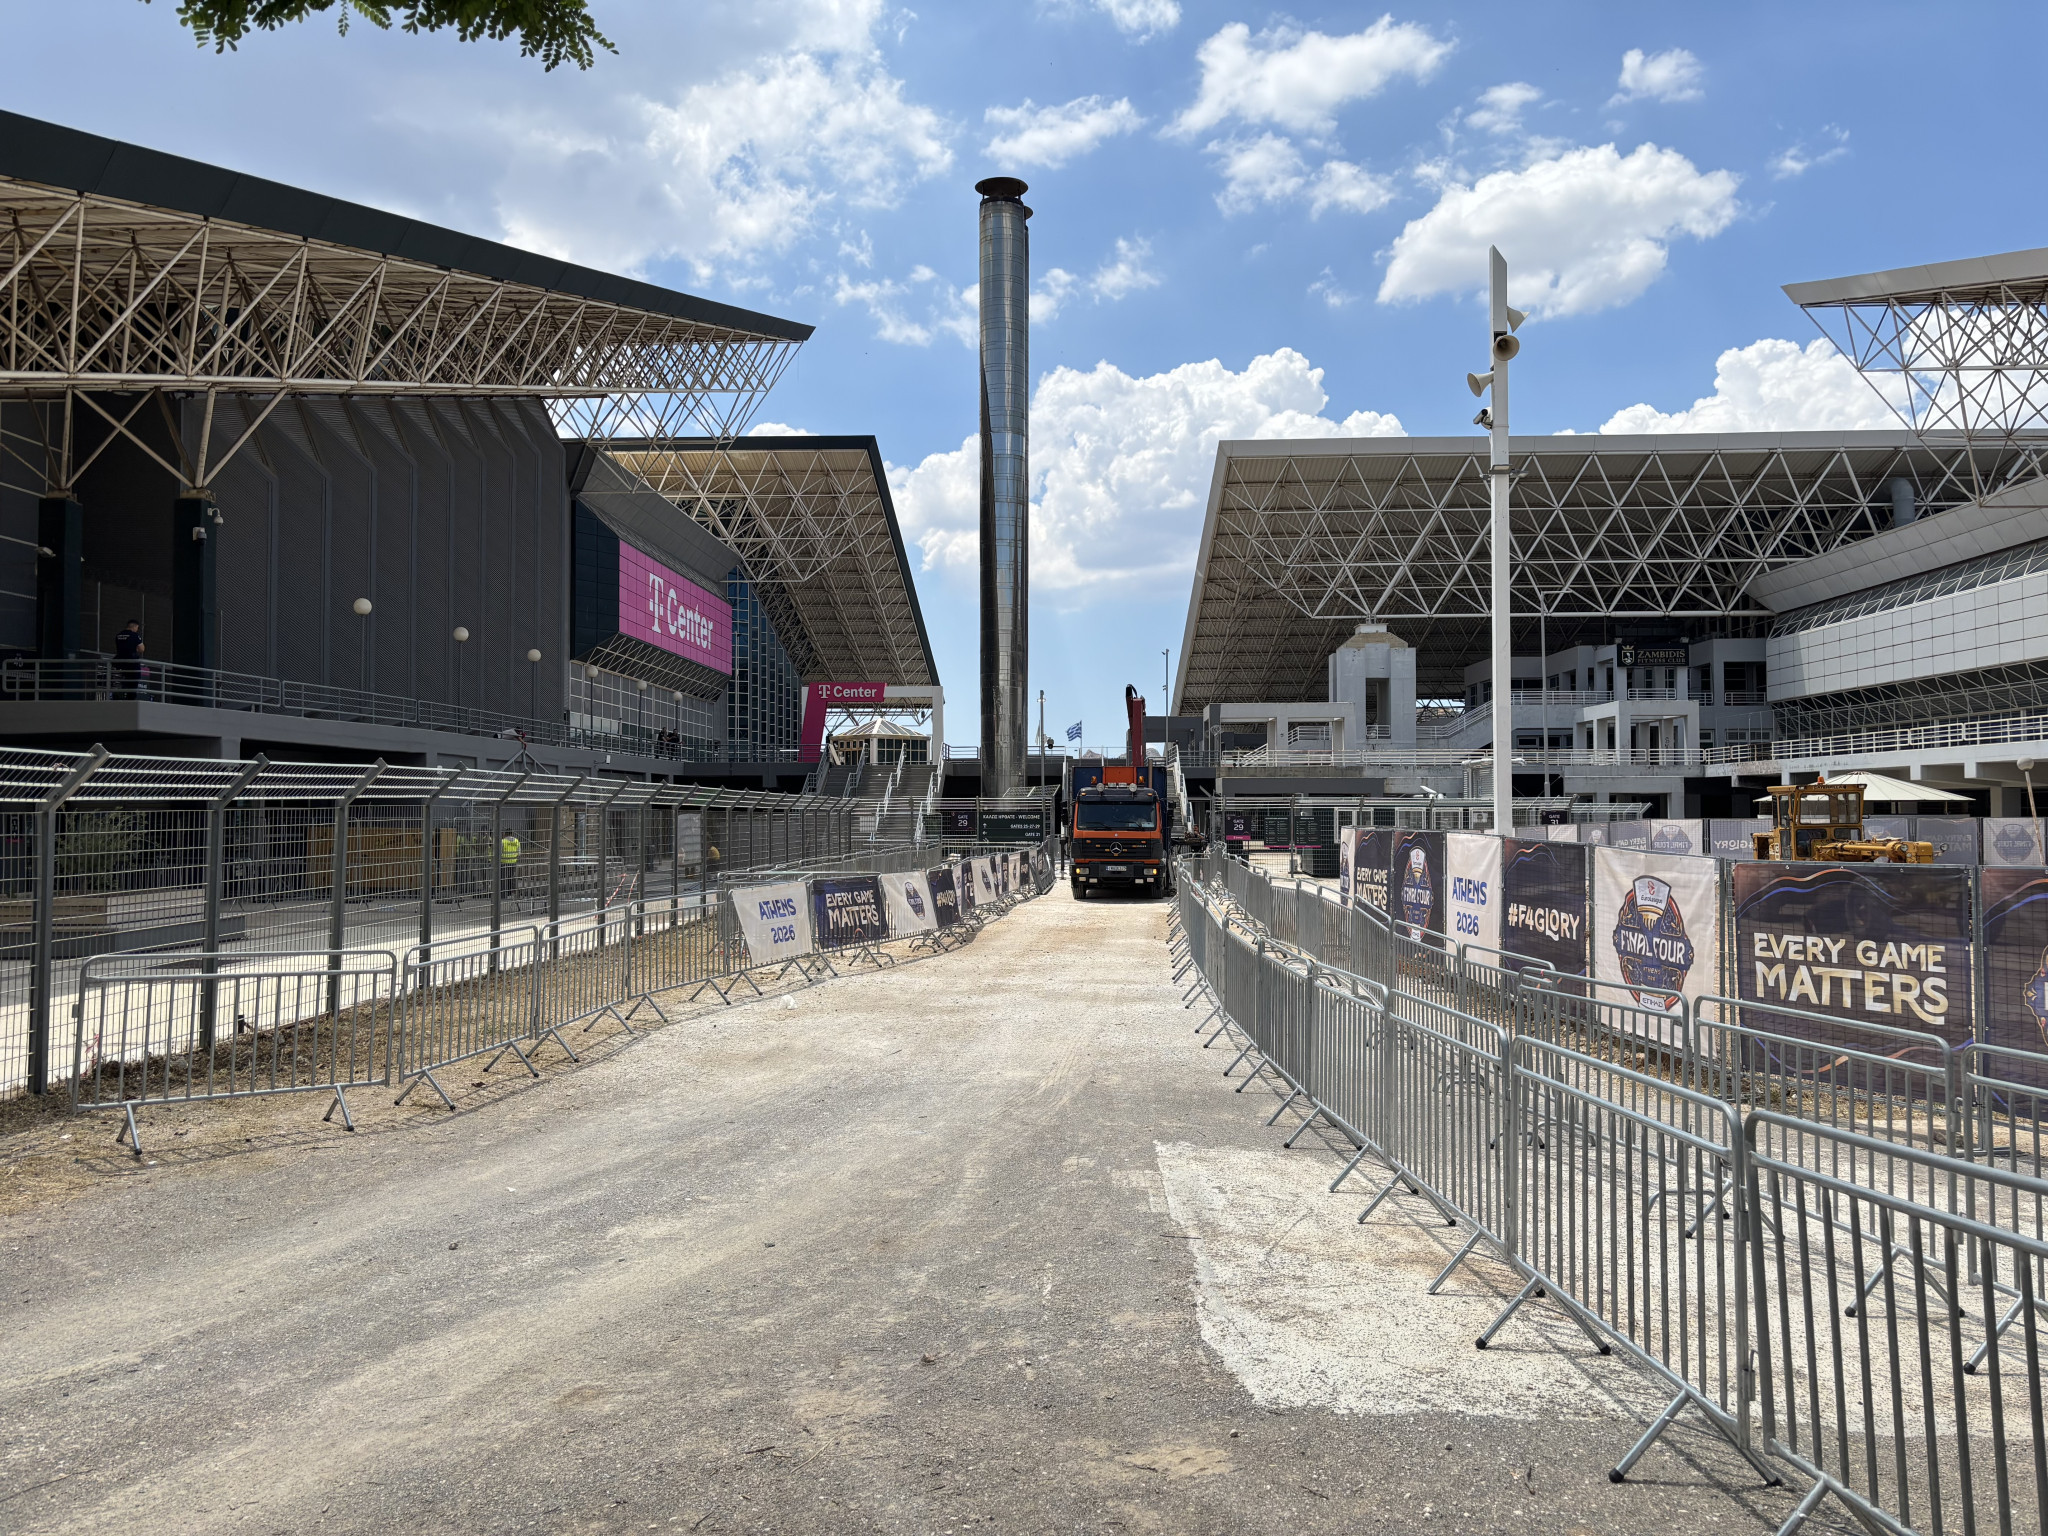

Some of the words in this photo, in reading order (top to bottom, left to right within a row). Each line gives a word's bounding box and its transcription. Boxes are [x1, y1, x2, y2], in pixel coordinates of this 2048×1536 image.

[650, 572, 664, 634] T
[668, 588, 714, 650] Center
[818, 684, 831, 699] T
[834, 686, 877, 698] Center
[1357, 867, 1372, 883] EVERY
[1372, 868, 1388, 883] GAME
[826, 892, 852, 907] EVERY
[853, 889, 875, 904] GAME
[1356, 883, 1387, 910] MATTERS
[1417, 888, 1430, 905] FOUR
[1452, 876, 1488, 906] ATHENS
[758, 898, 797, 921] ATHENS
[828, 904, 880, 930] MATTERS
[771, 924, 796, 944] 2026
[1456, 912, 1480, 936] 2026
[1508, 903, 1580, 942] #F4GLORY
[1620, 929, 1652, 957] FINAL
[1652, 937, 1686, 964] FOUR
[1753, 932, 1846, 964] EVERY
[1856, 940, 1946, 974] GAME
[1642, 998, 1663, 1007] ETIHAD
[1755, 961, 1949, 1026] MATTERS
